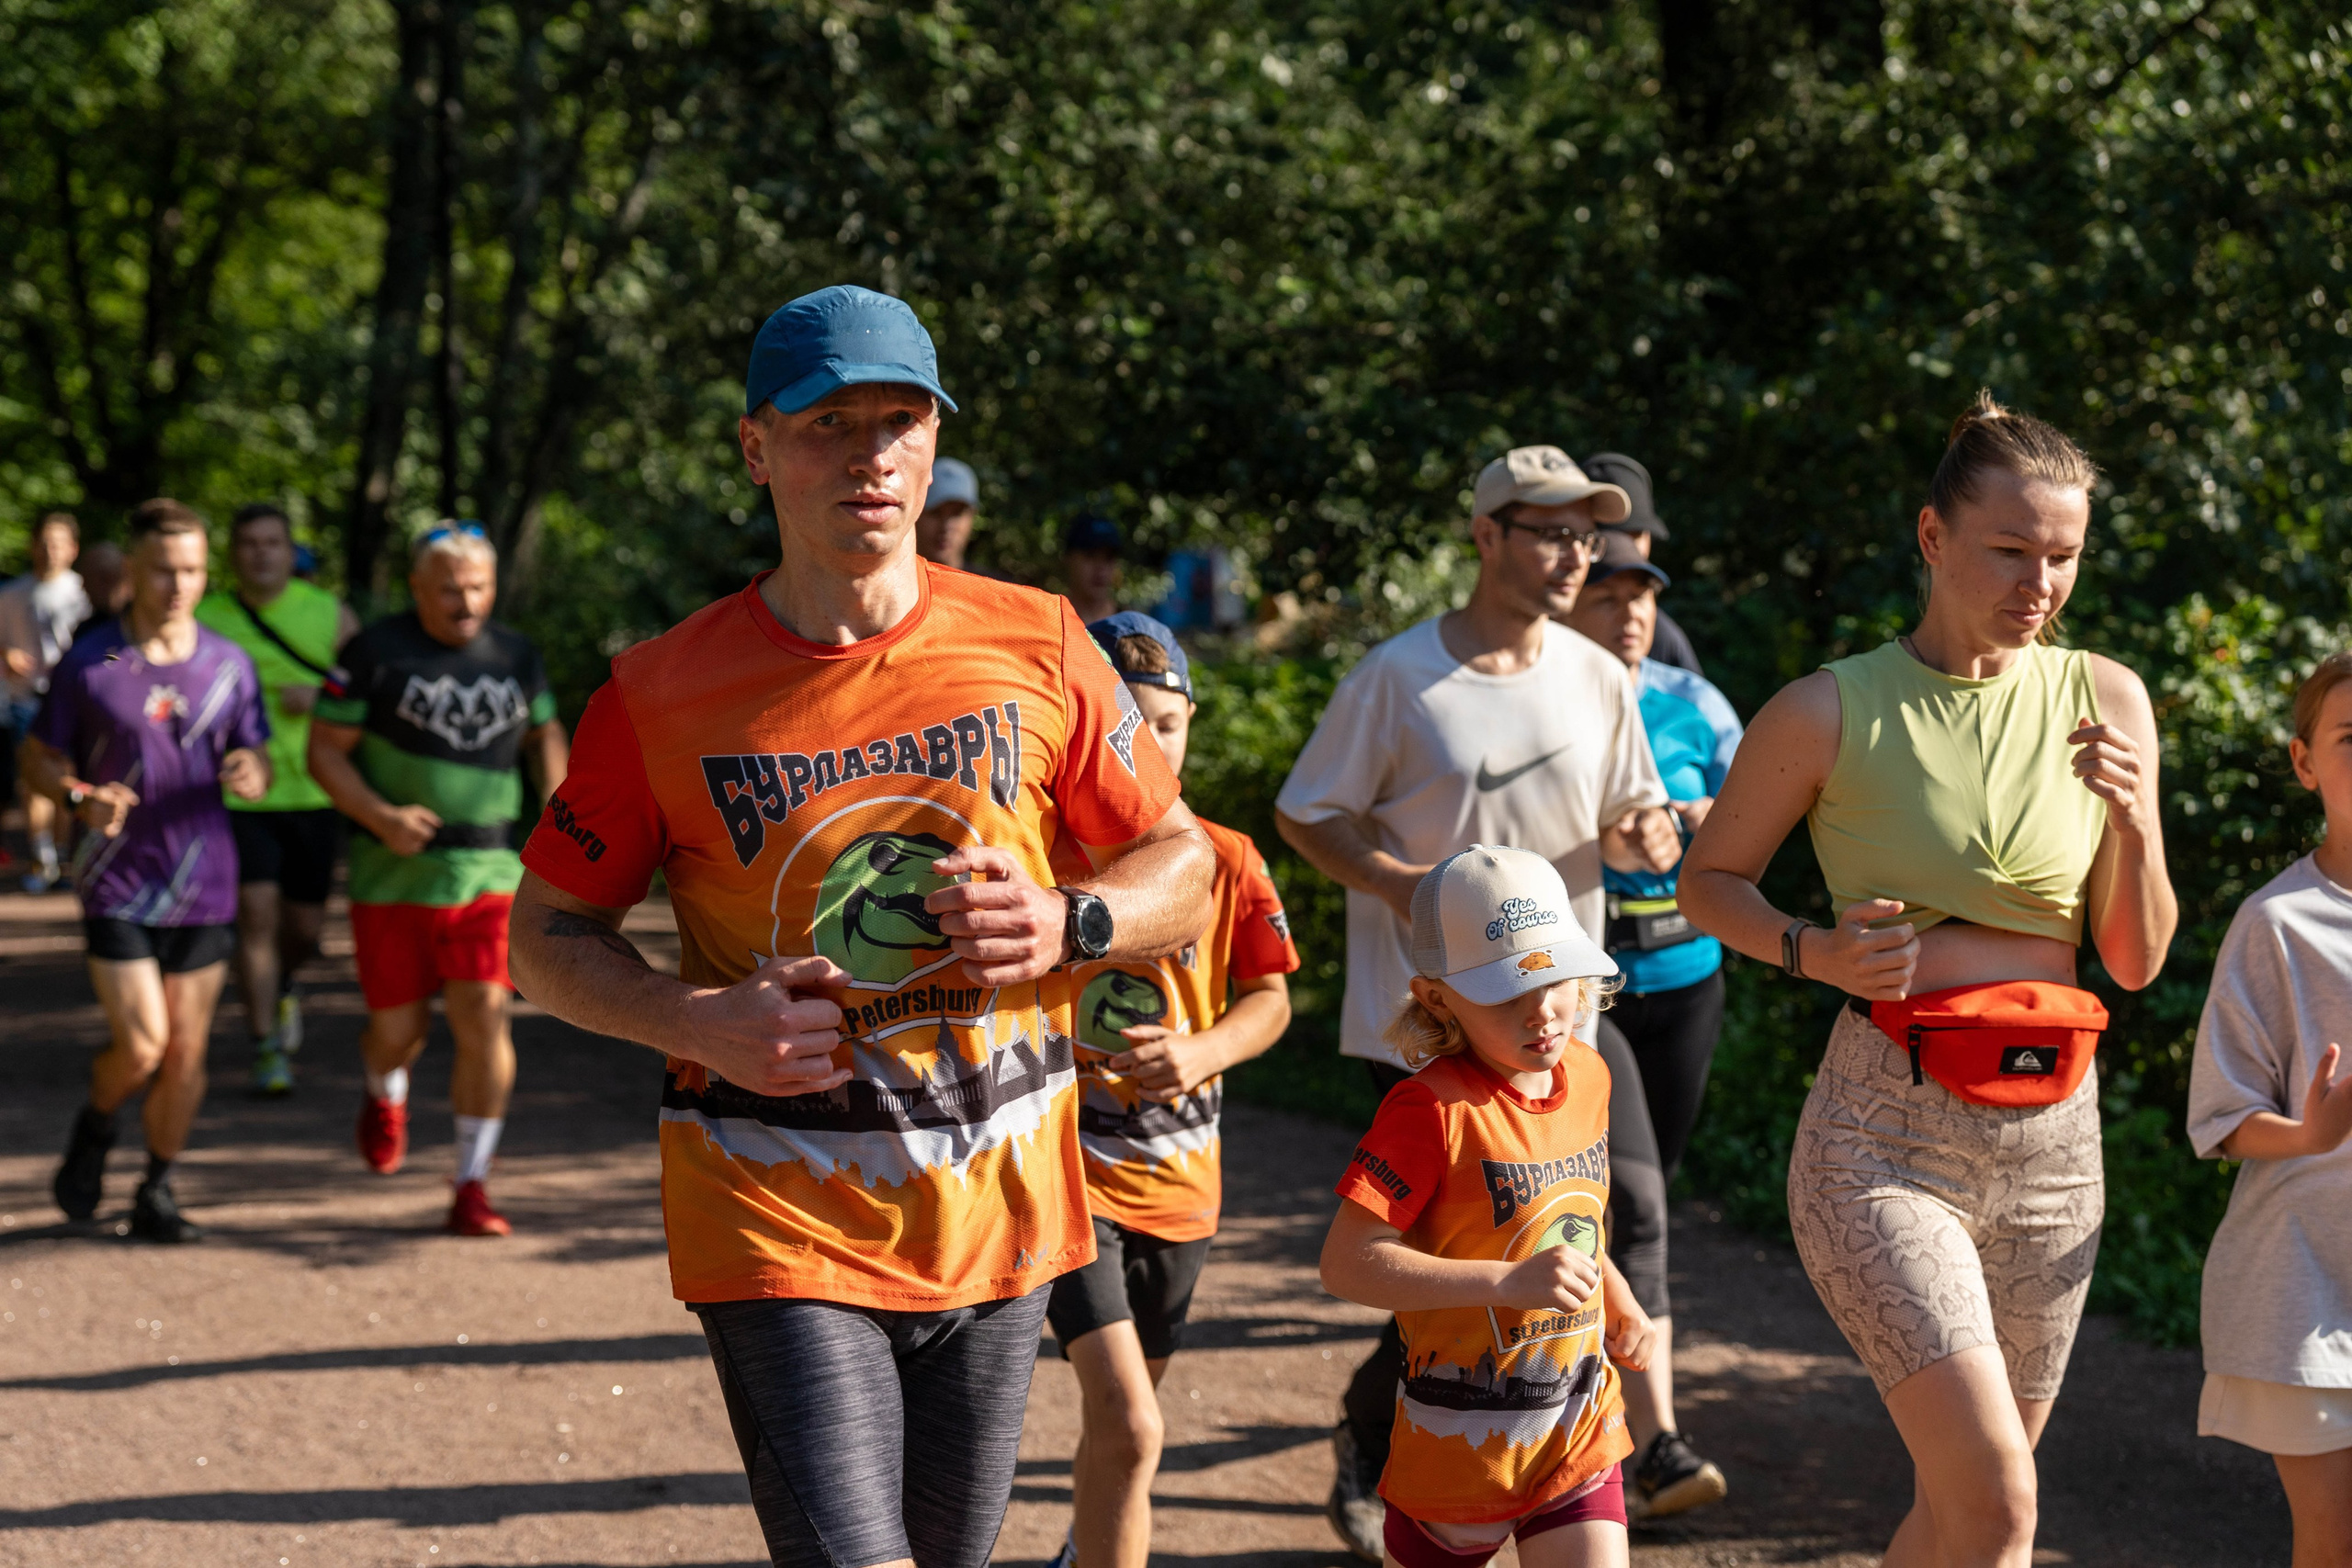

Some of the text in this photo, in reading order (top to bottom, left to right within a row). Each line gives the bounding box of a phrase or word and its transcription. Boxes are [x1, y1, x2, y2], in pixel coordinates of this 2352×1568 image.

[1105, 704, 1145, 778] БУРЛА
[700, 701, 1021, 870] БУРЛАЗАВРЫ
[1486, 911, 1557, 941] Of course
[1501, 897, 1537, 920] Yes
